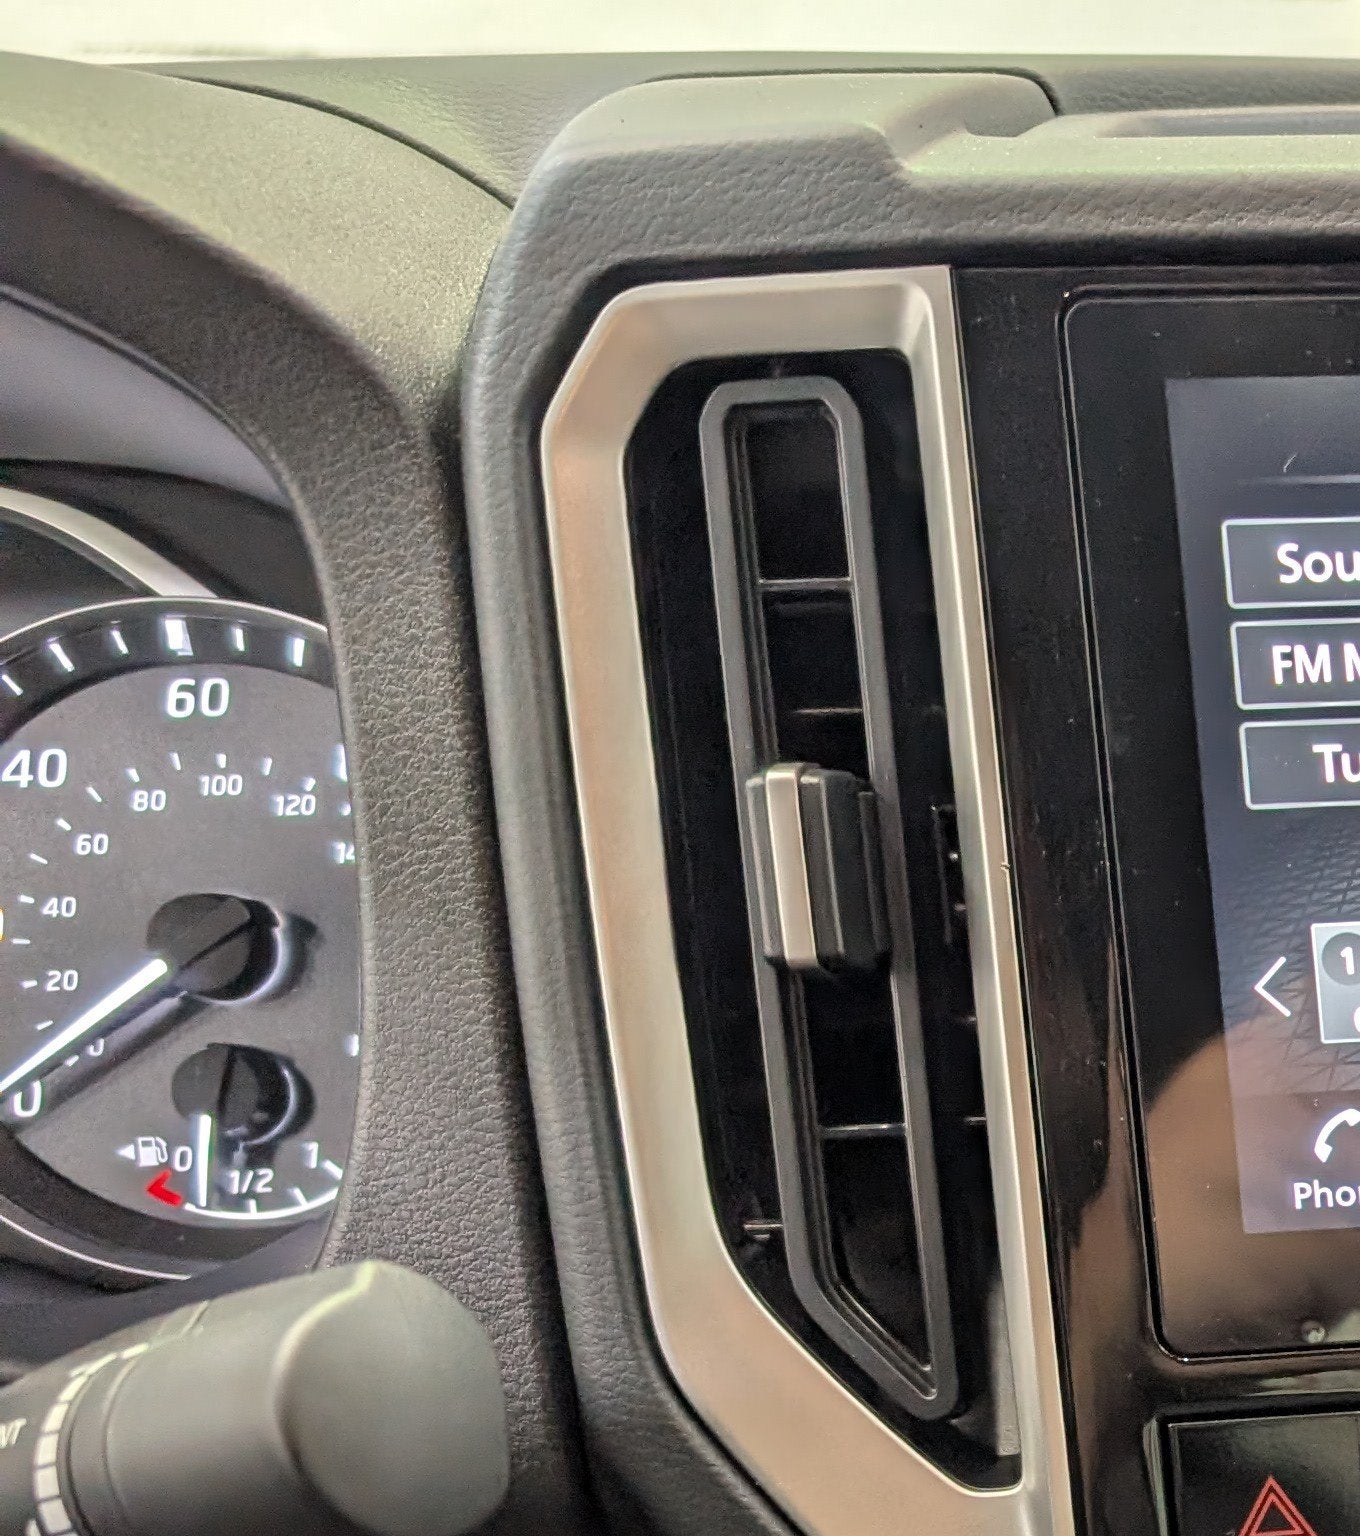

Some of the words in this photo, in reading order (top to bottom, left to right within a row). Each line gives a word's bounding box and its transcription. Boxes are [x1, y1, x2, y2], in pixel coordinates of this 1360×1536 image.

[1272, 644, 1332, 685] FM
[166, 677, 230, 718] 60
[1, 748, 68, 788] 40
[200, 774, 243, 797] 100
[132, 789, 166, 812] 80
[273, 794, 316, 817] 120
[75, 832, 109, 857] 60
[43, 896, 76, 919] 40
[1340, 947, 1355, 974] 1
[46, 970, 78, 993] 20
[174, 1146, 192, 1172] 0
[304, 1142, 318, 1169] 1
[225, 1169, 274, 1195] 1/2
